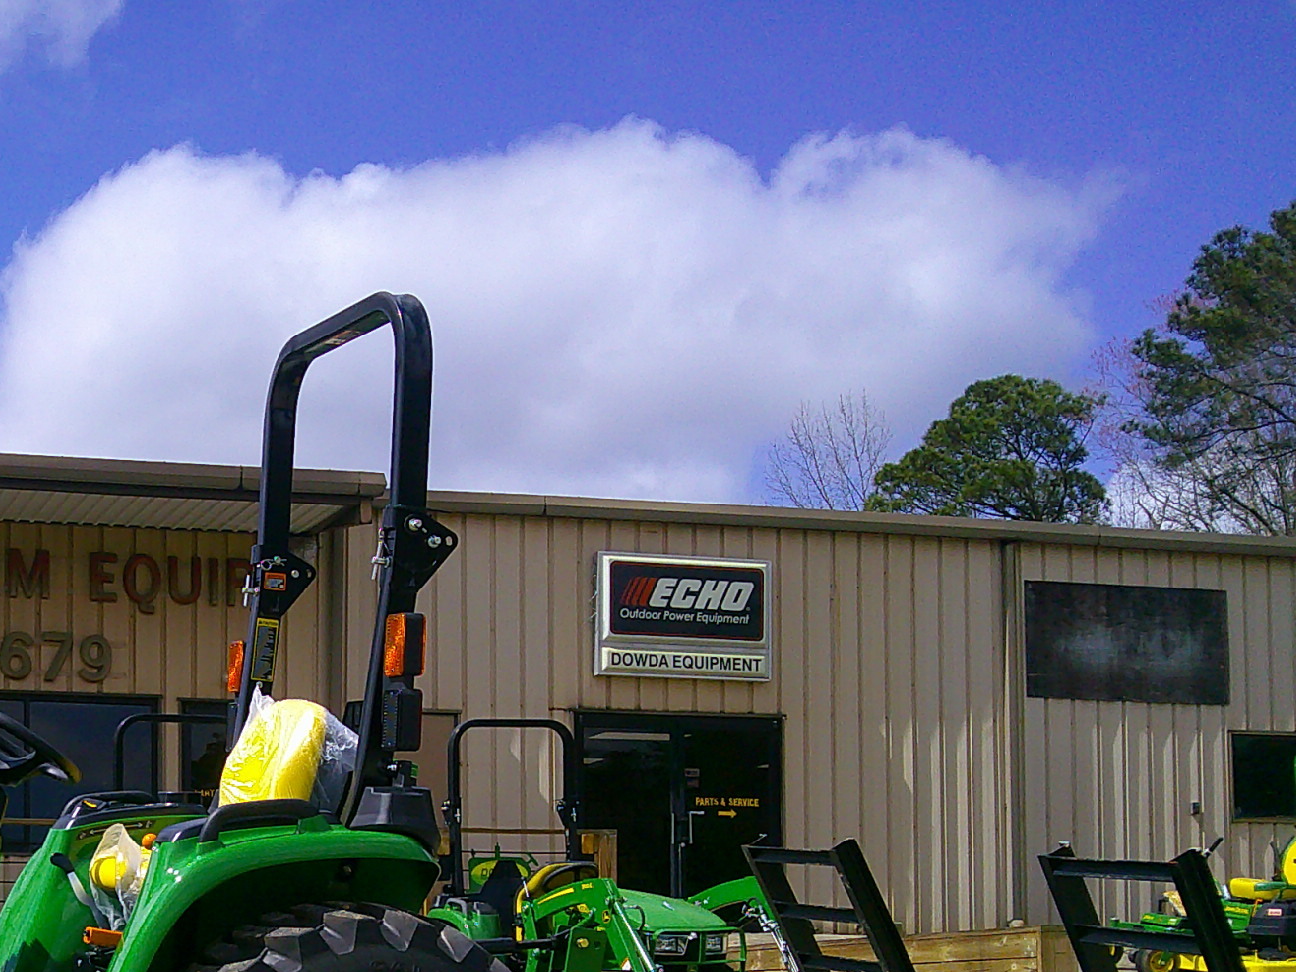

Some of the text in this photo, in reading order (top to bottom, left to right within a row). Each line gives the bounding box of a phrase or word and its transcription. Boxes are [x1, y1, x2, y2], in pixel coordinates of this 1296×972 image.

[649, 577, 755, 611] ECHO
[619, 607, 750, 625] Outdoor Power Equipment
[610, 651, 762, 673] DOWDA EQUIPMENT
[695, 796, 760, 808] PARTS & SERVICE
